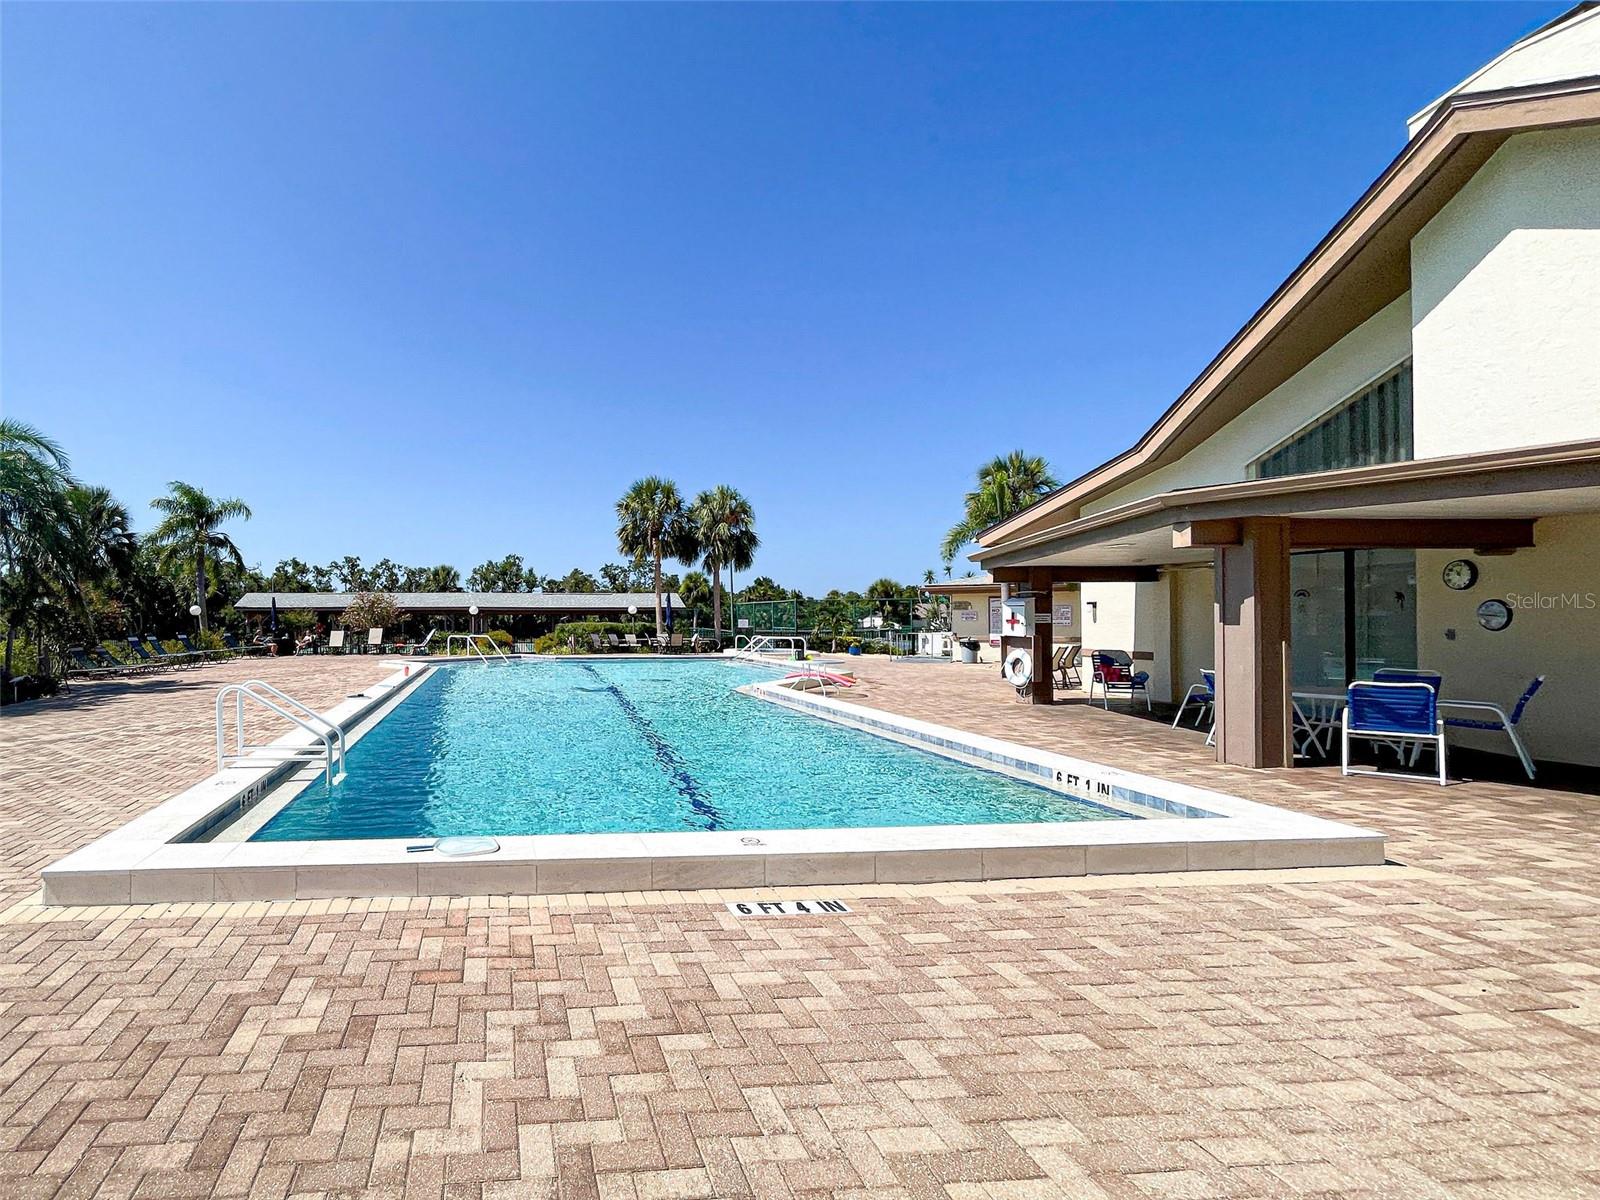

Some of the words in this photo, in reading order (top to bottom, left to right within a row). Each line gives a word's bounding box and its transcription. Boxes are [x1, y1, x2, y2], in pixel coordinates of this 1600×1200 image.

[1056, 771, 1062, 782] 6
[1067, 774, 1079, 786] FT
[1086, 779, 1090, 791] 1
[1097, 782, 1110, 796] IN
[736, 903, 752, 915] 6
[757, 902, 786, 914] FT
[795, 901, 811, 913] 4
[816, 900, 848, 912] IN
